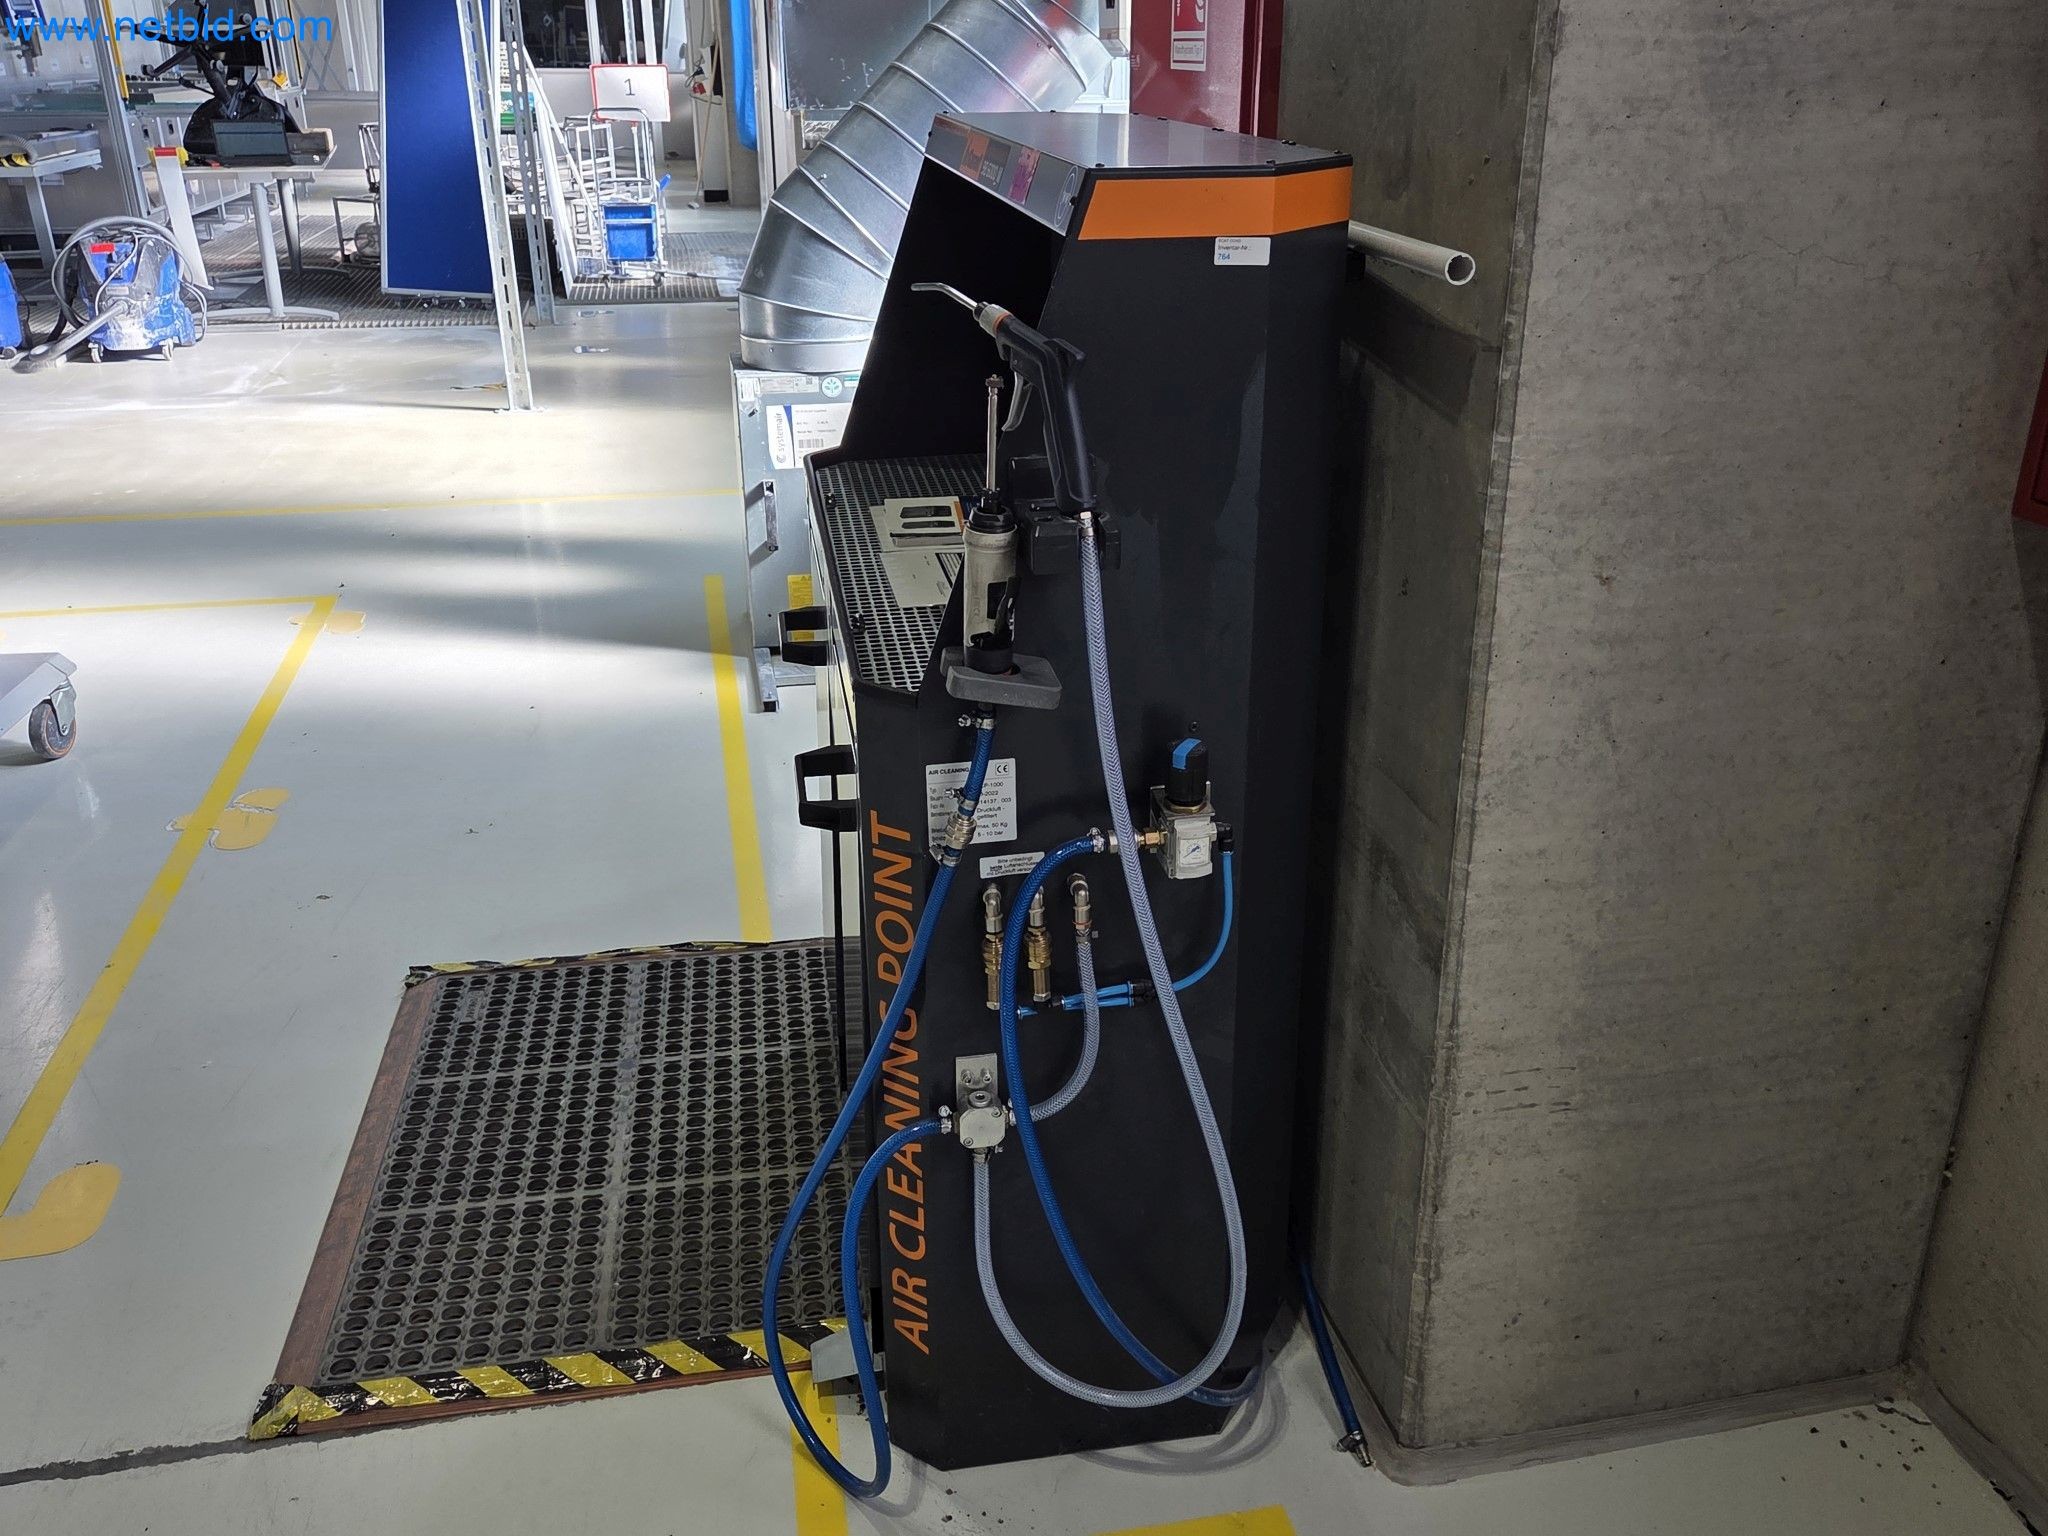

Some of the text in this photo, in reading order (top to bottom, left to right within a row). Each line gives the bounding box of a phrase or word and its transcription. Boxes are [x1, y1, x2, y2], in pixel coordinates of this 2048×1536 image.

[624, 78, 635, 96] 1
[774, 412, 785, 452] systemair
[940, 767, 969, 775] CLEANING
[870, 809, 915, 985] POINT
[891, 1267, 930, 1355] AIR
